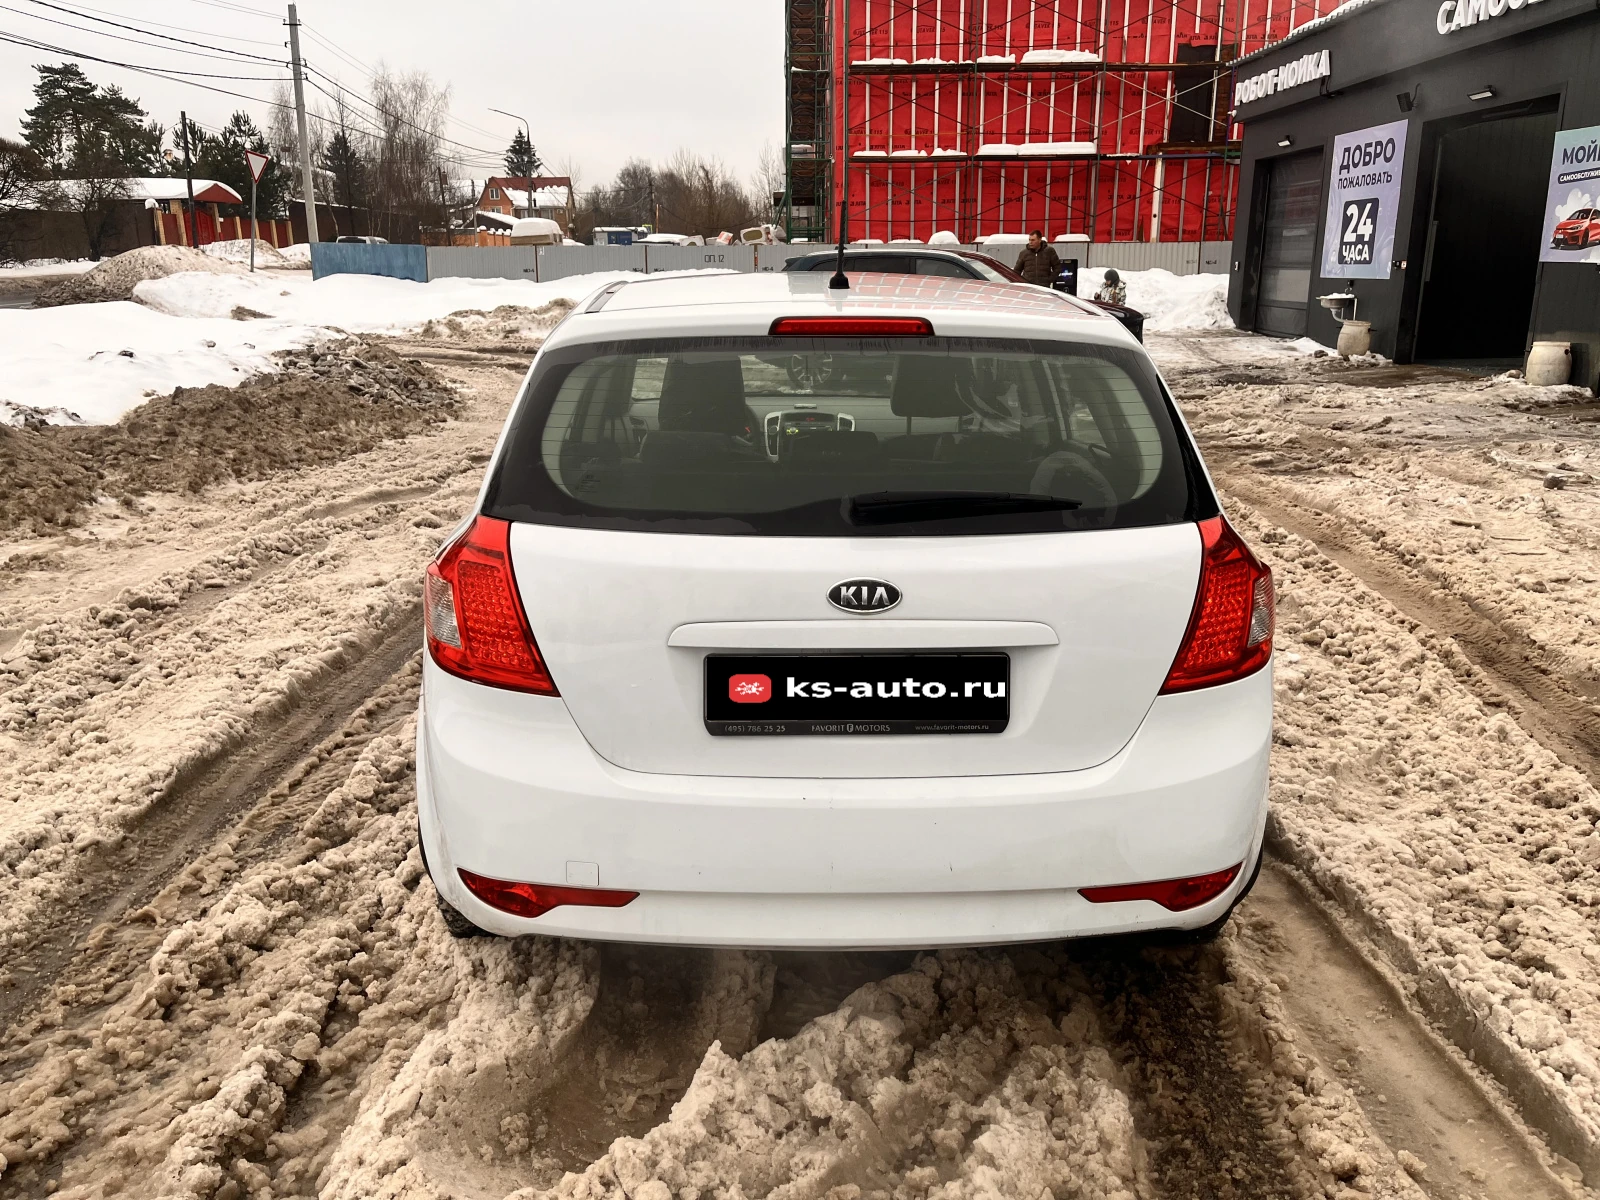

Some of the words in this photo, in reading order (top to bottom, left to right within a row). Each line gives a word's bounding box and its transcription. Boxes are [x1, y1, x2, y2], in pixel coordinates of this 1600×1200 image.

[1436, 0, 1544, 35] САМО
[1339, 137, 1396, 176] ДОБРО
[1562, 138, 1600, 166] МОЙ
[1338, 171, 1393, 190] ПОЖАЛОВАТЬ
[1343, 202, 1374, 243] 24
[1342, 244, 1370, 262] ЧАСА
[840, 585, 891, 606] KIA
[811, 724, 845, 732] FAVORIT
[855, 724, 890, 732] MOTORS
[914, 724, 990, 732] www.favorit-motors.ru
